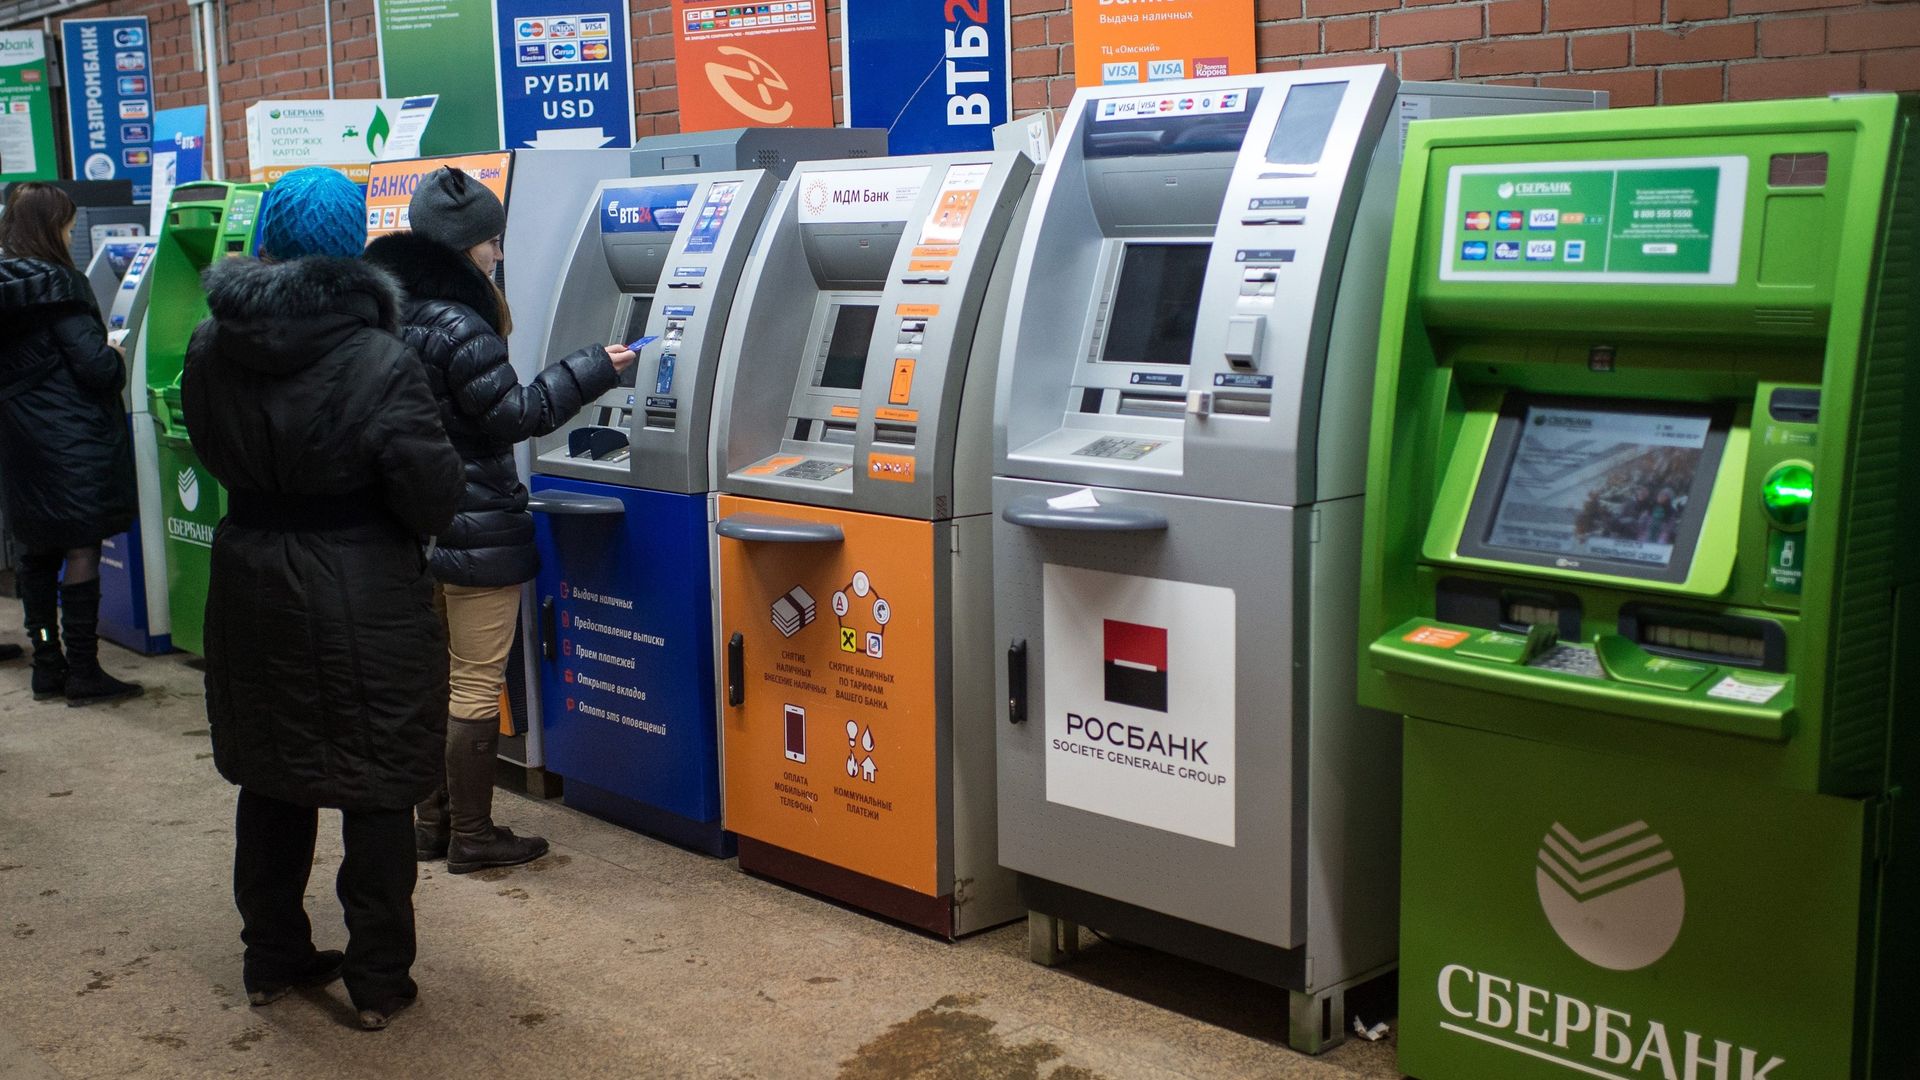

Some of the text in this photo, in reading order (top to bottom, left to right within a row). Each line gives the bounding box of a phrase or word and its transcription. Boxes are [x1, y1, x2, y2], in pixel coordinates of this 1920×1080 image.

[1099, 10, 1193, 25] Выдача наличных
[1101, 43, 1160, 55] ТЦ «Омский»
[1108, 65, 1137, 77] VISA
[1152, 63, 1182, 75] VISA
[1196, 69, 1227, 78] Корона
[80, 26, 107, 150] ГАЗПРОМБАНК
[525, 72, 609, 95] РУБЛИ
[283, 109, 324, 118] СБЕРБАНК
[542, 99, 595, 120] USD
[1118, 102, 1135, 112] VISA
[1141, 100, 1156, 109] VISA
[271, 127, 309, 135] ОПЛАТА
[272, 137, 322, 146] УСЛУГ ЖКХ
[272, 146, 311, 157] КАРТОЙ
[1515, 181, 1572, 194] СБЕРБАНК
[832, 189, 861, 205] МДМ
[863, 190, 889, 203] Банк
[619, 206, 652, 224] ВТБ24
[1533, 212, 1556, 223] VISA
[1530, 244, 1552, 254] VISA
[167, 516, 215, 542] СБЕРБАНК
[572, 586, 633, 610] Выдача наличных
[574, 615, 665, 647] Предоставление выписки
[575, 644, 635, 670] Прием платежей
[781, 650, 806, 664] СНЯТИЕ
[776, 662, 812, 678] НАЛИЧНЫХ
[828, 660, 895, 684] СНЯТИЕ НАЛИЧНЫХ
[577, 672, 646, 701] Открытие вкладов
[764, 672, 827, 695] ВНЕСЕНИЕ НАЛИЧНЫХ
[839, 676, 884, 695] ПО ТАРИФАМ
[835, 688, 888, 710] ВАШЕГО БАНКА
[578, 701, 666, 736] Оплата sms оповещений
[1066, 712, 1209, 765] РОСБАНК
[1053, 738, 1226, 787] SOCIETE GENERALE GROUP
[783, 771, 808, 787] ОПЛАТА
[774, 781, 819, 802] МОБИЛЬНОГО
[833, 786, 893, 812] КОММУНАЛЬНЫЕ
[780, 796, 814, 814] ТЕЛЕФОНА
[846, 803, 879, 821] ПЛАТЕЖИ
[1437, 963, 1787, 1080] СБЕРБАНК
